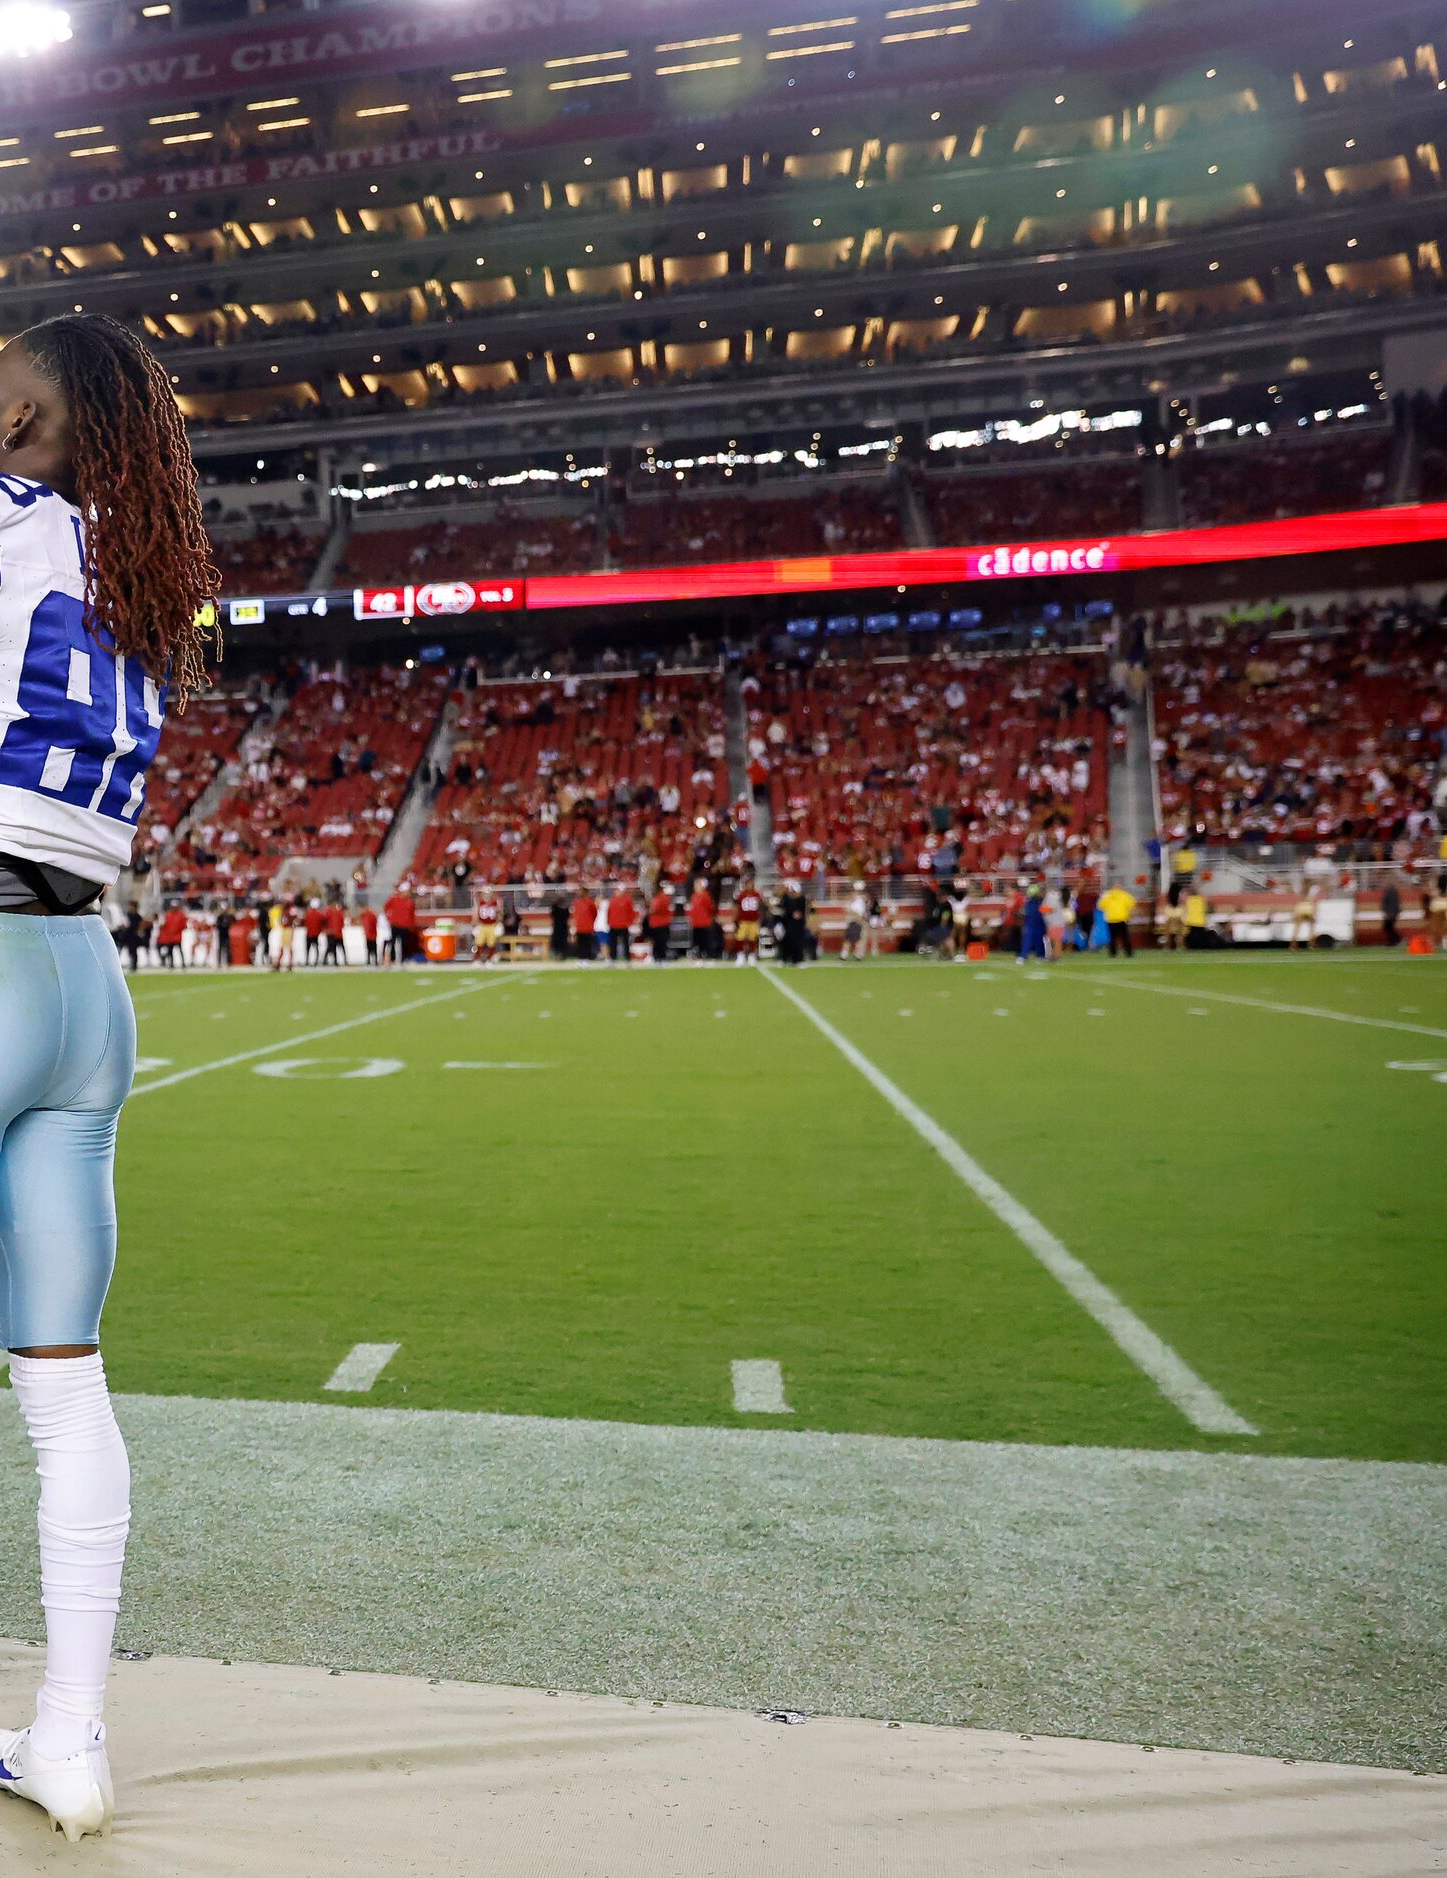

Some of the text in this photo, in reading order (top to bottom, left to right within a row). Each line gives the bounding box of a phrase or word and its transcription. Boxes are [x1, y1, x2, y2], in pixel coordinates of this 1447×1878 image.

[56, 53, 217, 99] BOWL
[229, 4, 600, 72] CHAMPIONS
[88, 177, 149, 203] OF
[156, 163, 249, 196] THE
[267, 130, 502, 181] FAITHFUL
